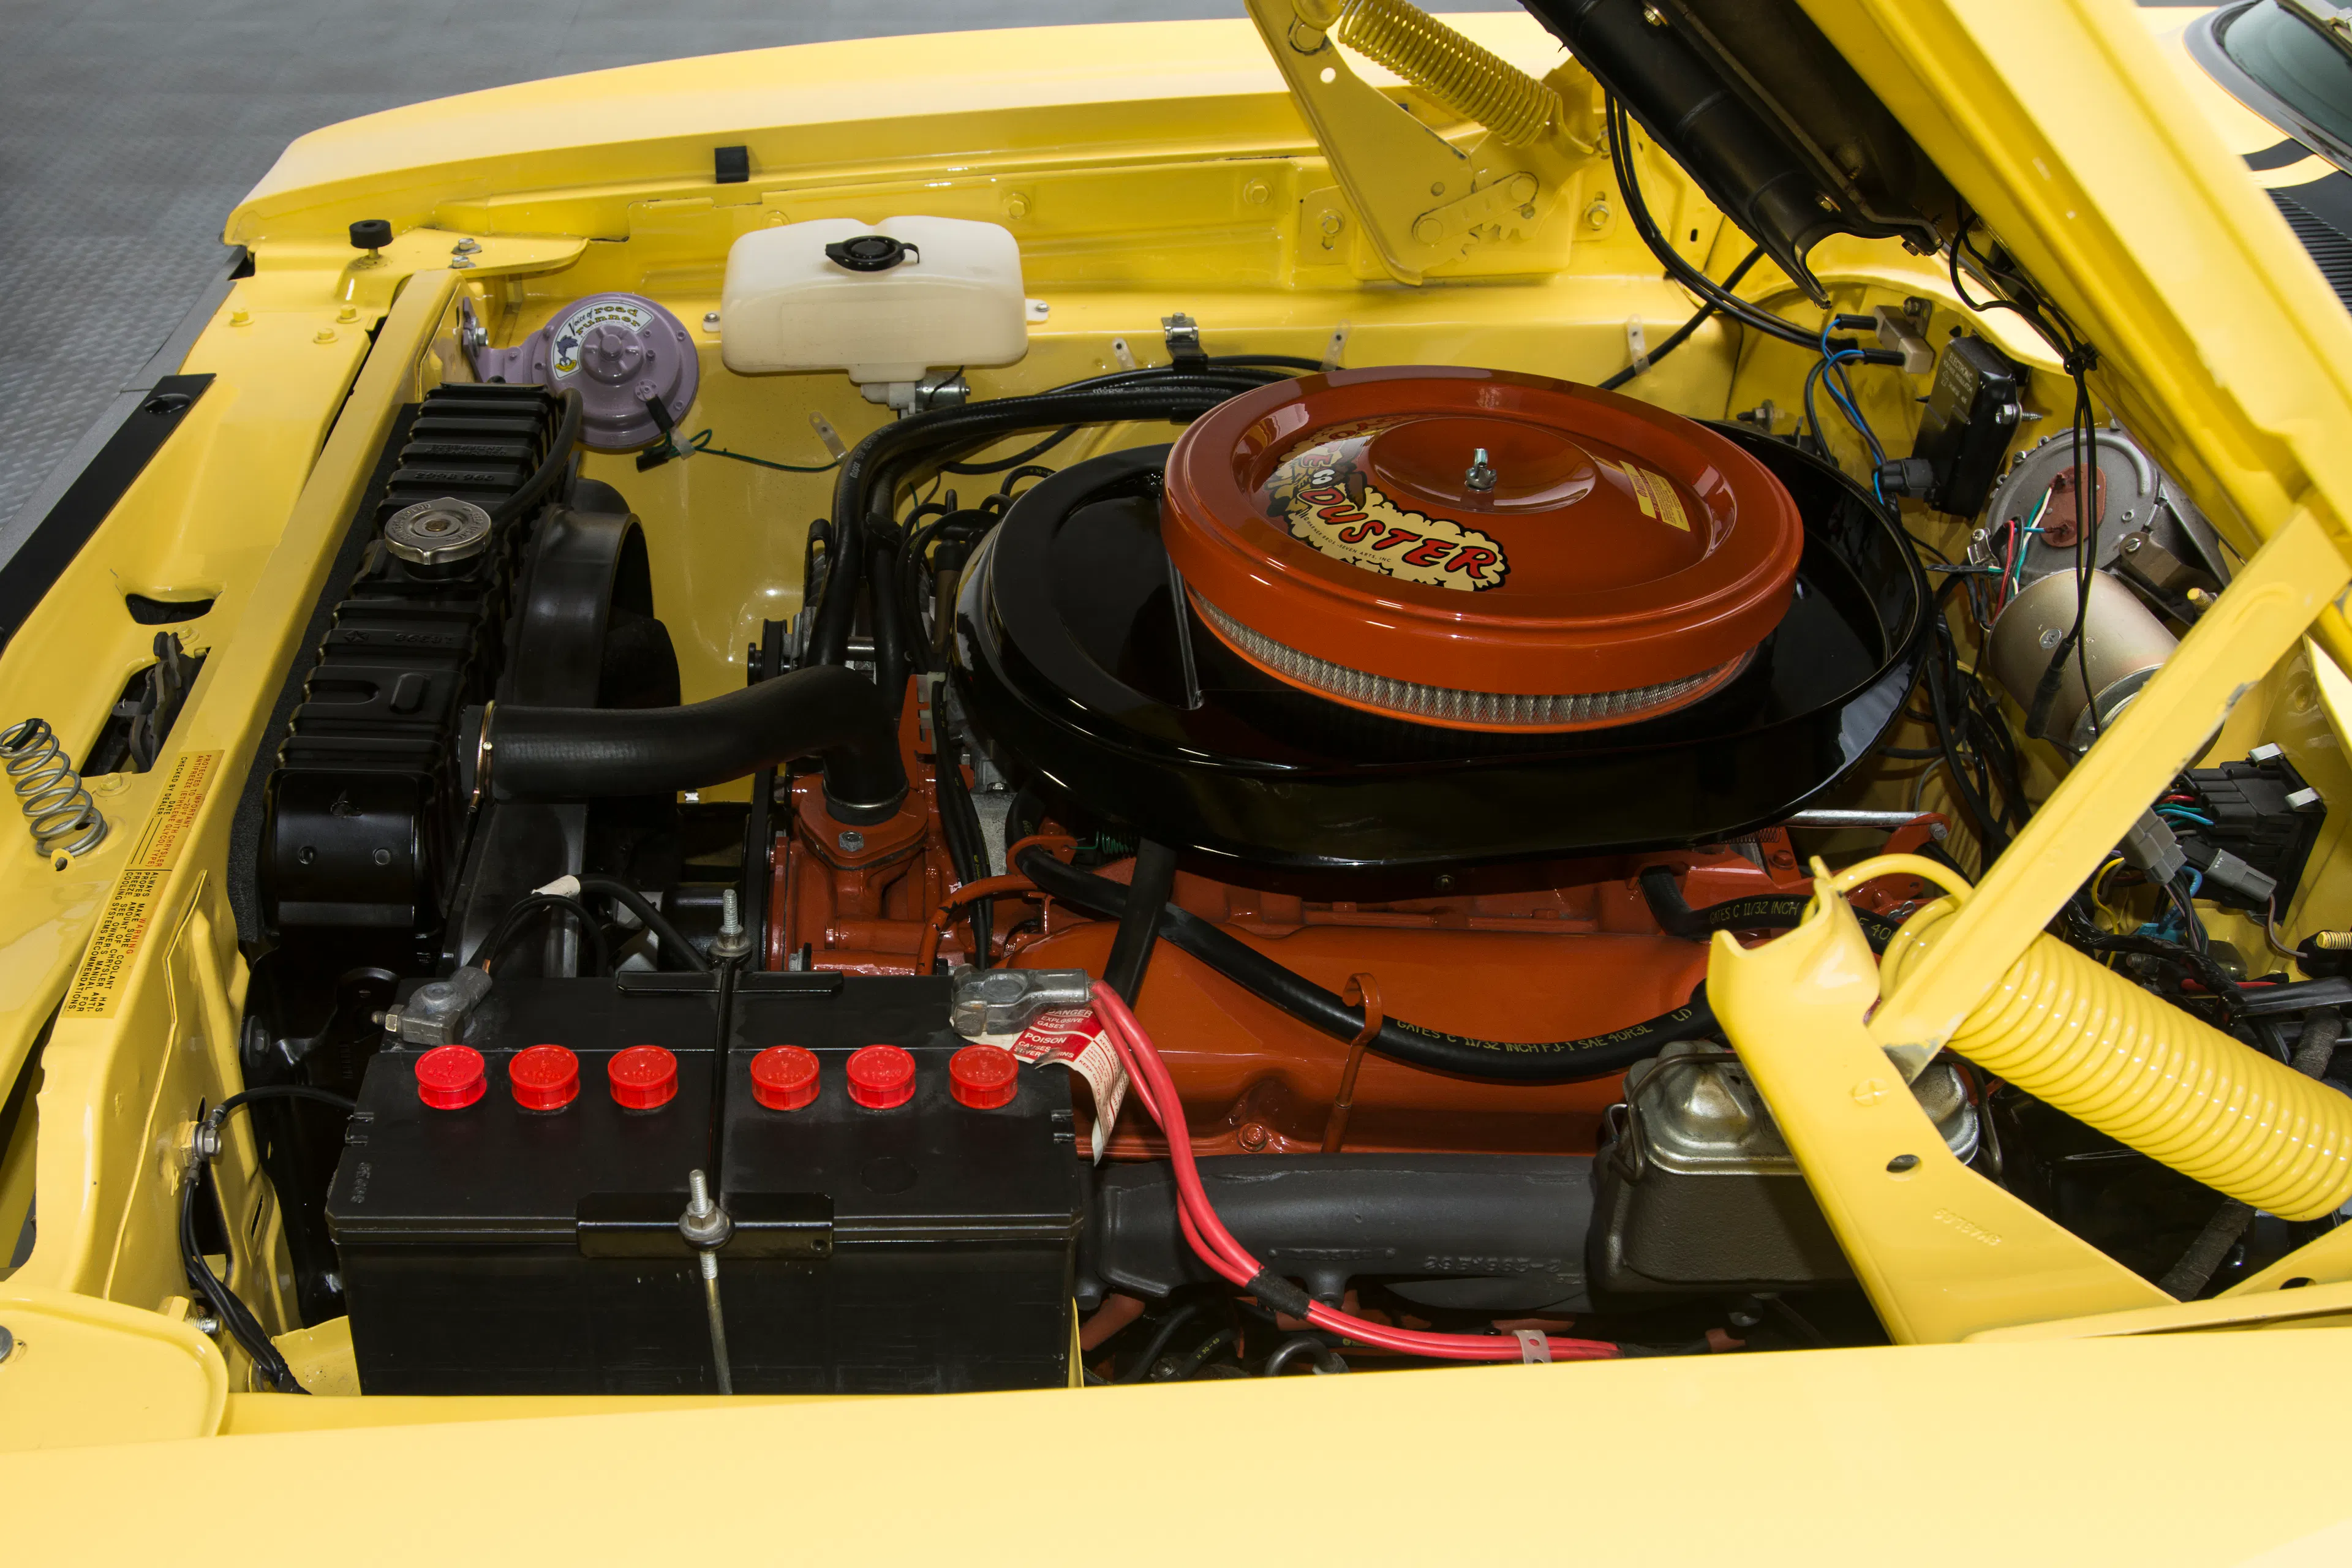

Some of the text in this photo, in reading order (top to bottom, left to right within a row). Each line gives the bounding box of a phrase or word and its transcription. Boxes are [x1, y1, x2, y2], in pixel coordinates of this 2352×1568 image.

[567, 314, 586, 336] Voice
[586, 307, 593, 318] of
[594, 306, 639, 317] road
[575, 314, 641, 336] runner
[1949, 352, 1973, 383] ELECTRONIC
[1298, 486, 1498, 579] DUSTER
[171, 756, 188, 782] CHECKED
[192, 754, 212, 786] PROTECTED
[145, 755, 203, 867] ANTIFREEZE (ETHYLENE GLYCOL TYPE)
[154, 793, 172, 816] DEALER:
[163, 800, 176, 815] DATE
[181, 793, 202, 828] IMPORTANT
[170, 818, 183, 833] WITH
[154, 835, 175, 867] CHRYSLER
[1709, 901, 1800, 924] GATES C 11/32 INCH
[66, 872, 134, 1011] COOLING SYSTEMS RECOMMENDATIONS.
[75, 872, 142, 1012] FREEZE. SEE OWNER'S MANUAL FOR
[86, 872, 151, 1012] PROPER AMOUNT OF CHRYSLER ANTI-
[94, 872, 159, 1012] ALWAYS MAKE SURE COOLANT HAS
[126, 918, 147, 954] WARNING
[1037, 1020, 1065, 1029] GASES
[1047, 1008, 1093, 1017] DANGER
[1025, 1032, 1067, 1044] POISON
[1099, 1039, 1110, 1052] KEEP
[1396, 1020, 1441, 1039] GATES
[1446, 1034, 1457, 1042] C
[1462, 1037, 1501, 1050] 11/32
[1504, 1042, 1539, 1054] INCH
[1577, 1036, 1608, 1049] SAE
[1079, 1060, 1093, 1072] KEEP
